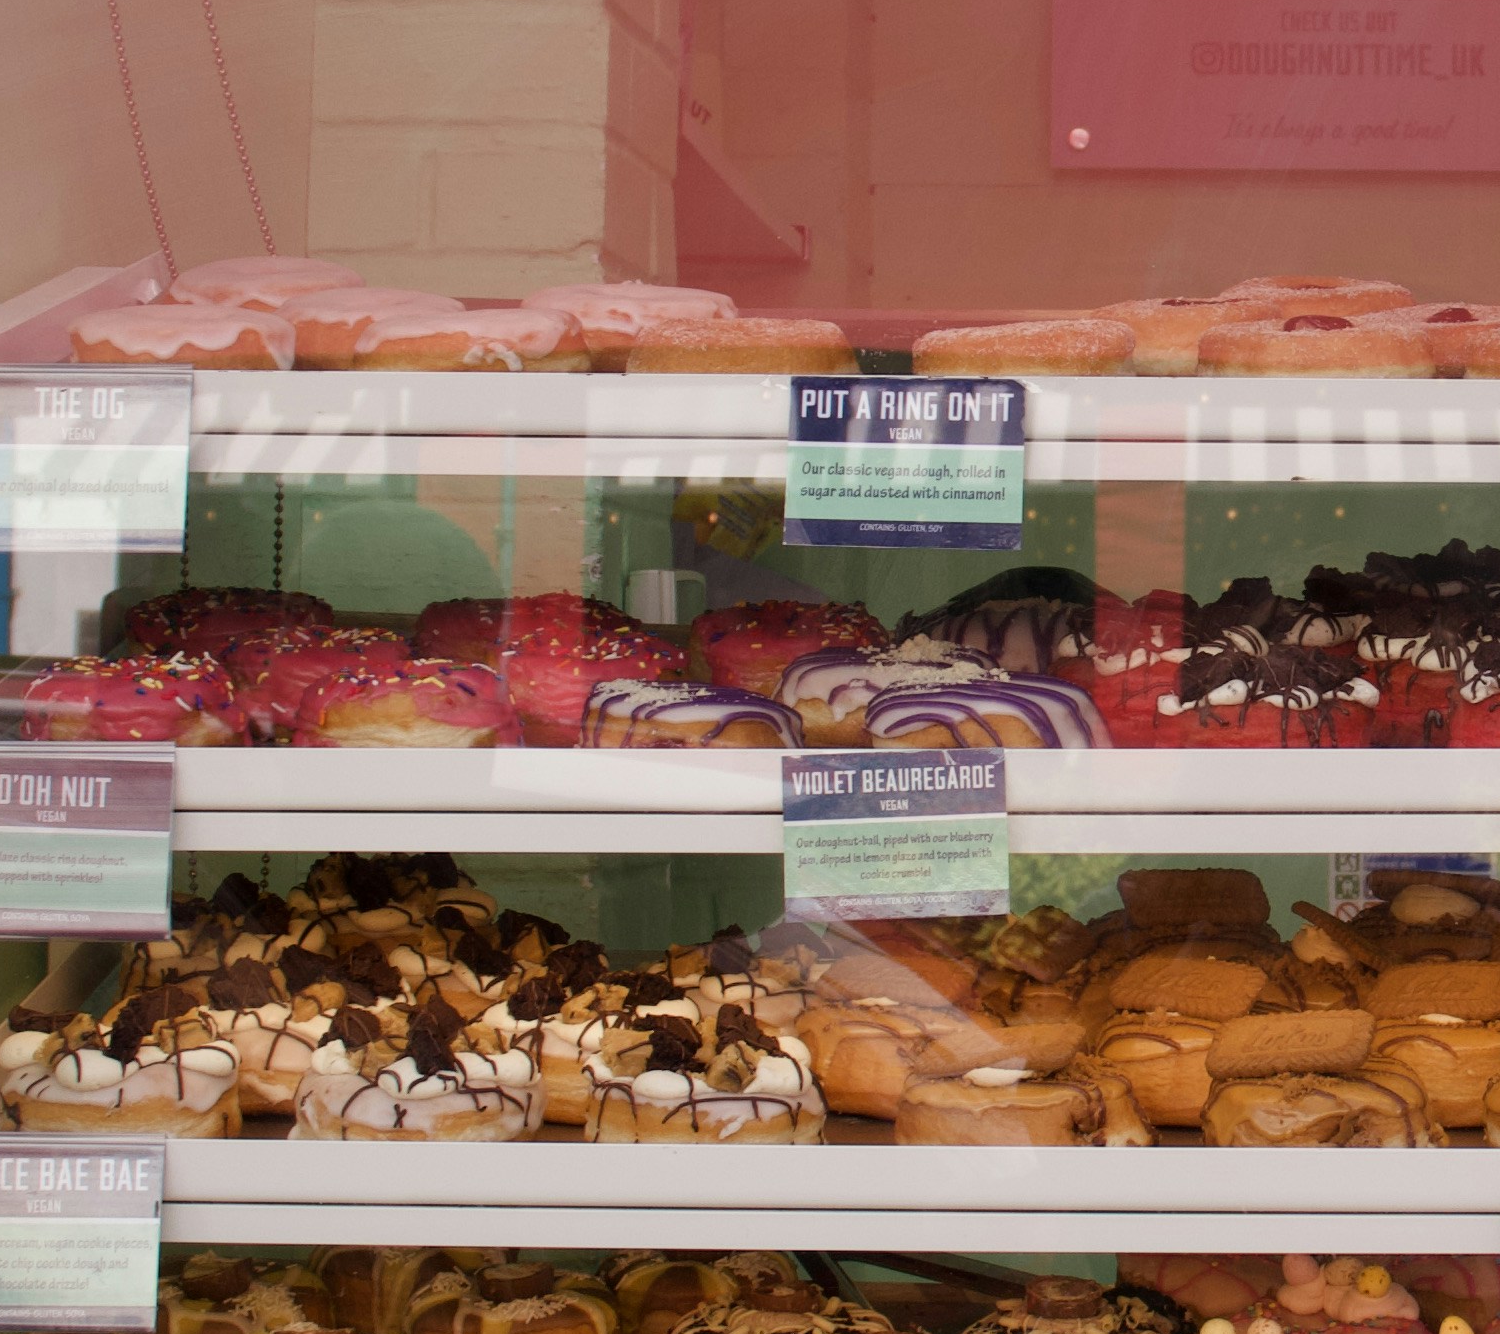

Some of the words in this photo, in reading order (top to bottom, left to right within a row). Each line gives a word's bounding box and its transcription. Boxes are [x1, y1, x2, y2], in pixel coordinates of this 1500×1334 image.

[1280, 9, 1332, 33] CHECK
[1338, 9, 1361, 33] US
[1365, 9, 1399, 33] OUT
[34, 386, 83, 419] THE
[91, 386, 125, 420] OG
[801, 388, 849, 418] PUT
[855, 389, 870, 419] A
[880, 390, 937, 420] RING
[948, 392, 980, 421] ON
[991, 392, 1014, 421] IT
[60, 427, 95, 442] VEGAN
[889, 427, 921, 441] VEGAN
[801, 459, 825, 475] Our
[826, 460, 872, 476] classic
[873, 465, 909, 480] vegan
[911, 462, 953, 481] dough,
[955, 464, 991, 478] rolled
[994, 465, 1005, 479] in
[799, 486, 837, 501] sugar
[837, 484, 861, 498] and
[863, 485, 909, 499] dusted
[911, 486, 940, 499] with
[941, 487, 1005, 501] cinnamon!
[792, 769, 856, 795] VIOLET
[862, 764, 995, 792] BEAUREGARDE
[60, 775, 111, 808] NUT
[36, 809, 66, 822] VEGAN
[879, 798, 908, 811] VEGAN
[39, 1158, 89, 1191] BAE
[99, 1158, 149, 1191] BAE
[26, 1198, 61, 1213] VEGAN
